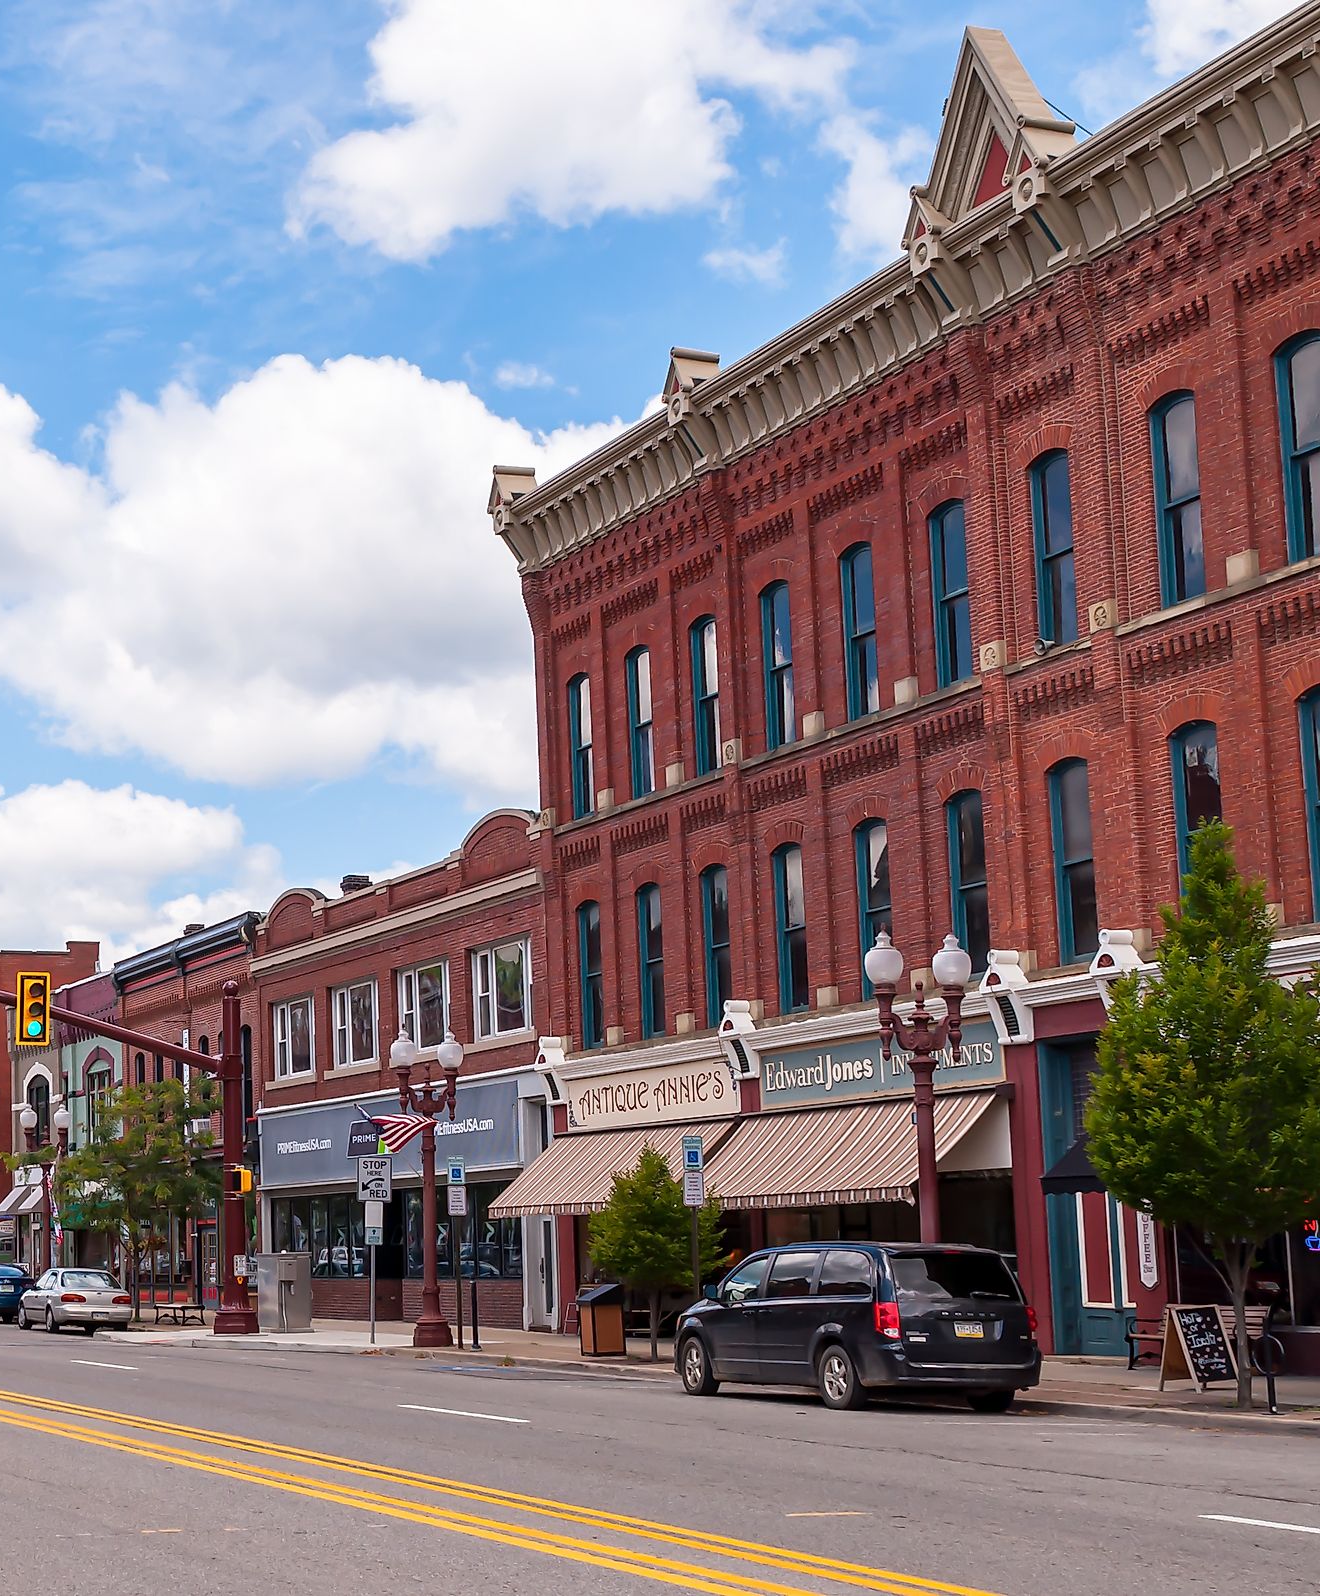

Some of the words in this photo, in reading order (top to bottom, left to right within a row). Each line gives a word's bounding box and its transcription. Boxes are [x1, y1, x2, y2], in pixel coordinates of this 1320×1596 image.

[891, 1042, 993, 1075] INVTMNTS
[578, 1081, 649, 1120] ANTIQUE
[653, 1070, 724, 1112] ANNIE'S
[277, 1138, 332, 1154] PRIMEfitnessUSA.com
[352, 1133, 376, 1144] PRIME
[362, 1160, 388, 1170] STOP
[369, 1190, 388, 1198] RED
[1141, 1213, 1152, 1263] OFFEE
